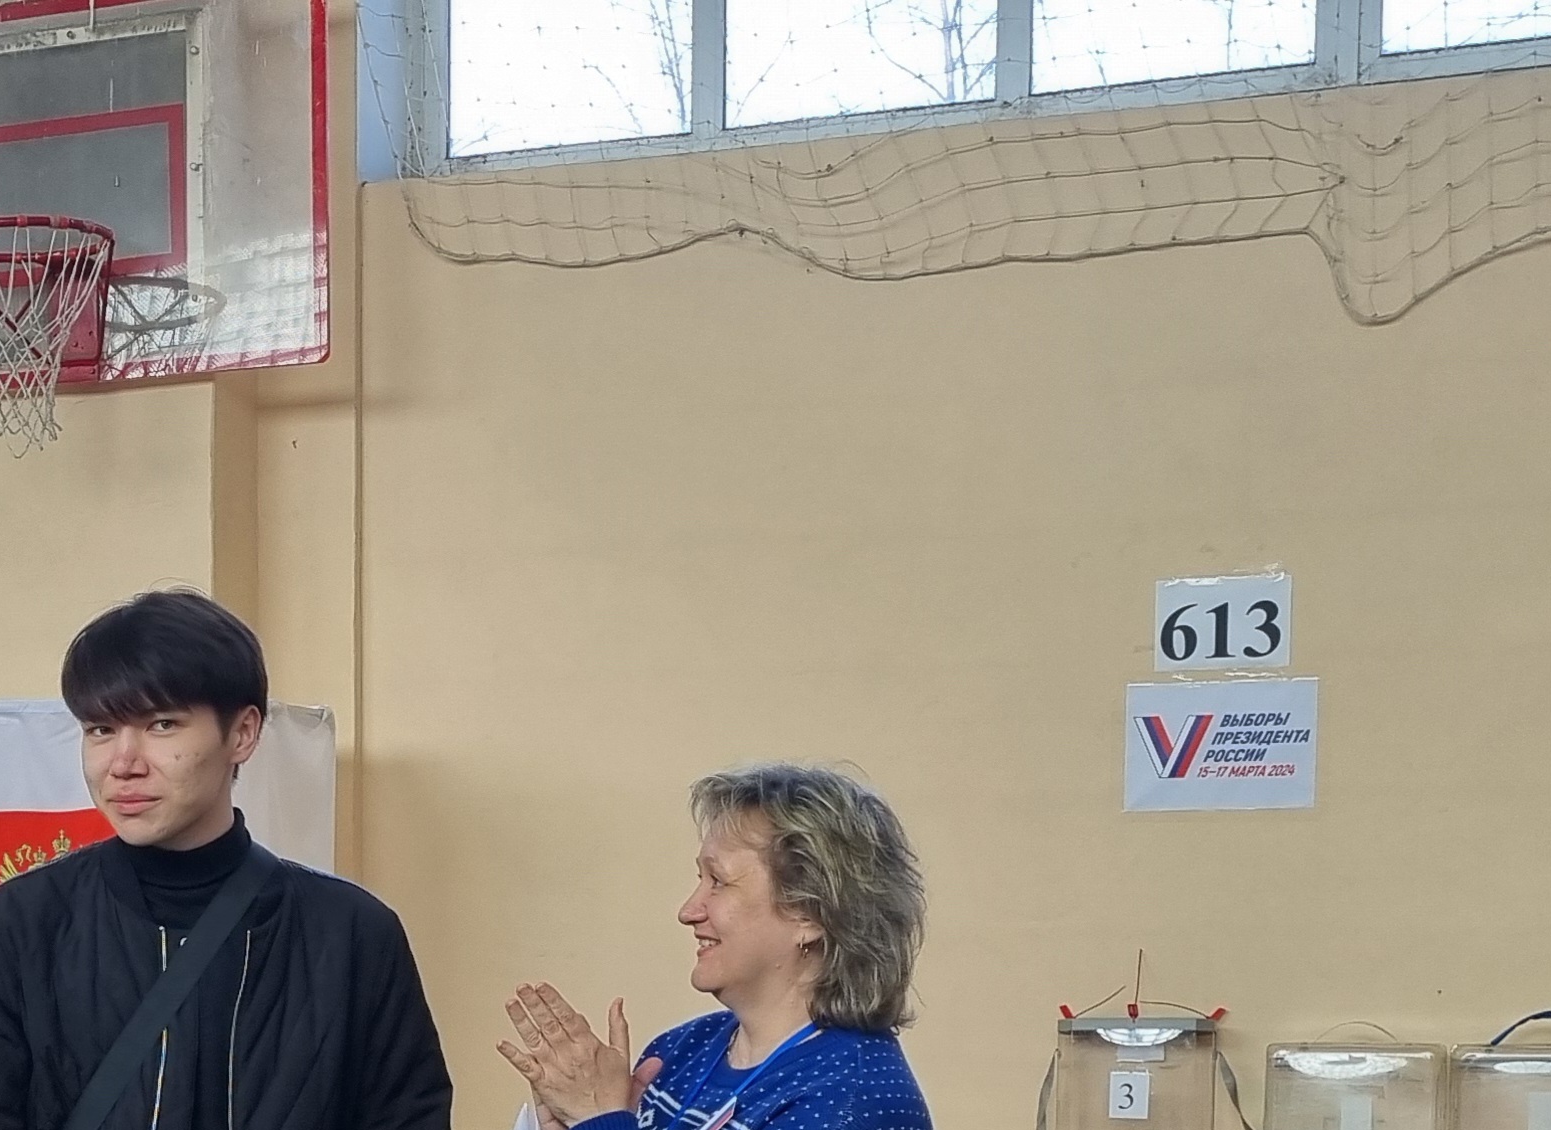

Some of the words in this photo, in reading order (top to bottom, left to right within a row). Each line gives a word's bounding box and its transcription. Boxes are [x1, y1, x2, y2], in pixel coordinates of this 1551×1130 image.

[1159, 599, 1282, 661] 613
[1219, 712, 1291, 728] ВЫБОРЫ
[1211, 729, 1311, 746] ПРЕЗИДЕНТА
[1203, 748, 1268, 763] РОССИИ
[1228, 765, 1267, 778] МАРТА
[1267, 764, 1296, 777] 2024
[1117, 1082, 1134, 1110] 3
